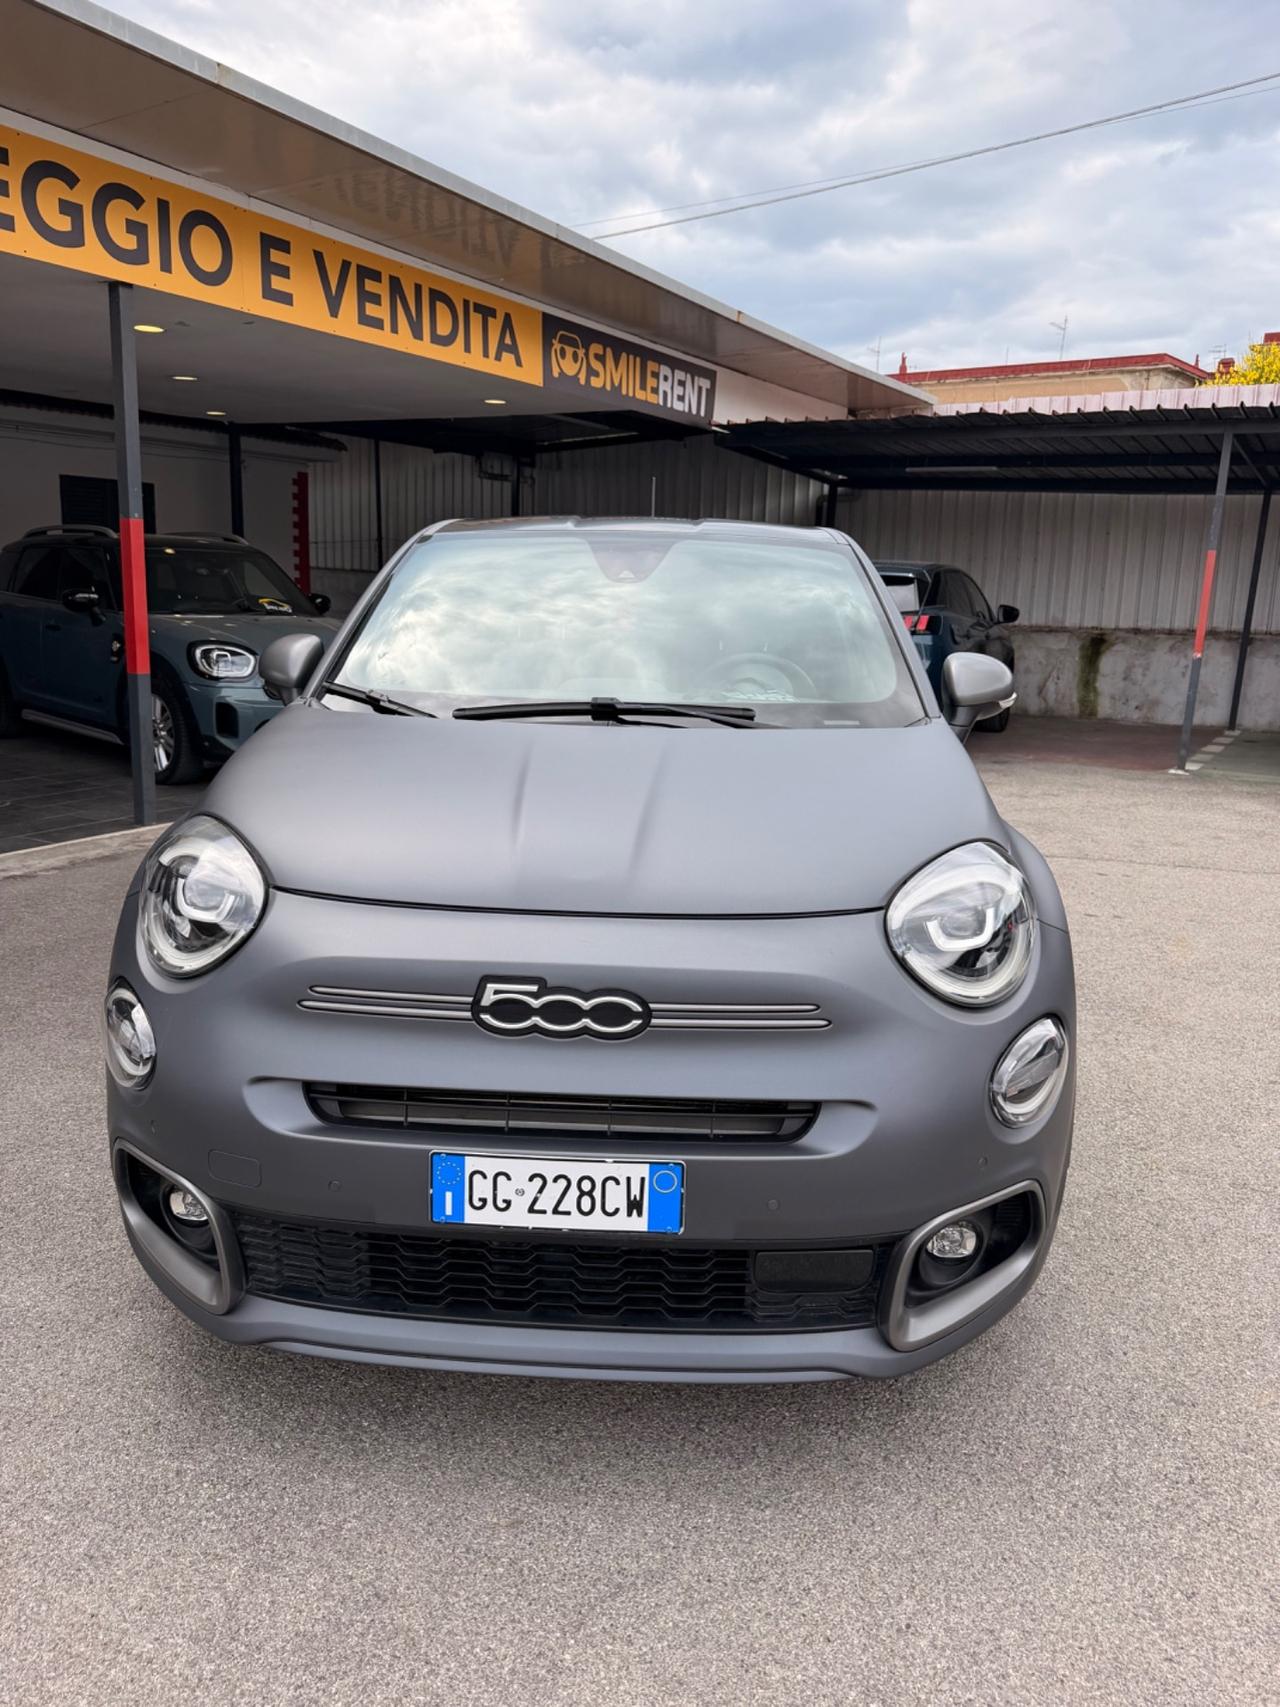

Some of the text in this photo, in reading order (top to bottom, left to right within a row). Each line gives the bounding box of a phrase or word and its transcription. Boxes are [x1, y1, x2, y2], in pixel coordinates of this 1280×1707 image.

[260, 232, 294, 307] E
[312, 249, 523, 368] VENDITA
[588, 342, 711, 418] SMILERENT
[479, 983, 643, 1033] 500
